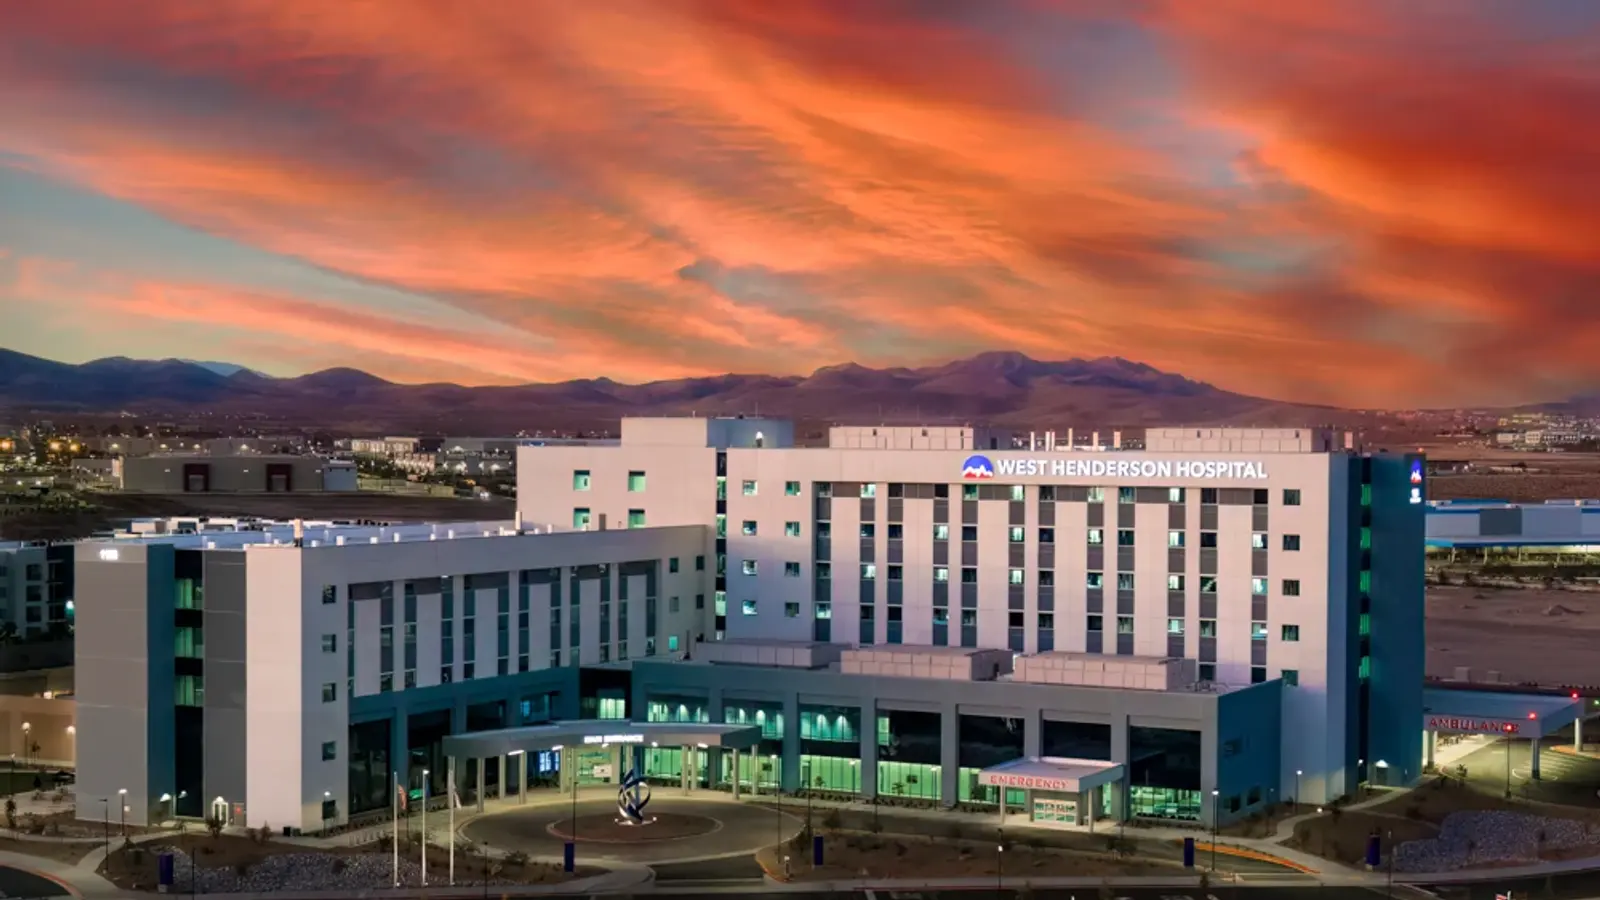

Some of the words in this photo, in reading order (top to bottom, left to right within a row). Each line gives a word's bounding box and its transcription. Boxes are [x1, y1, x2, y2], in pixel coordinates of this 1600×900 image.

[997, 459, 1048, 475] WEST
[1052, 460, 1171, 478] HENDERSON
[1176, 461, 1268, 478] HOSPITAL
[990, 775, 1068, 789] EMERGENCY
